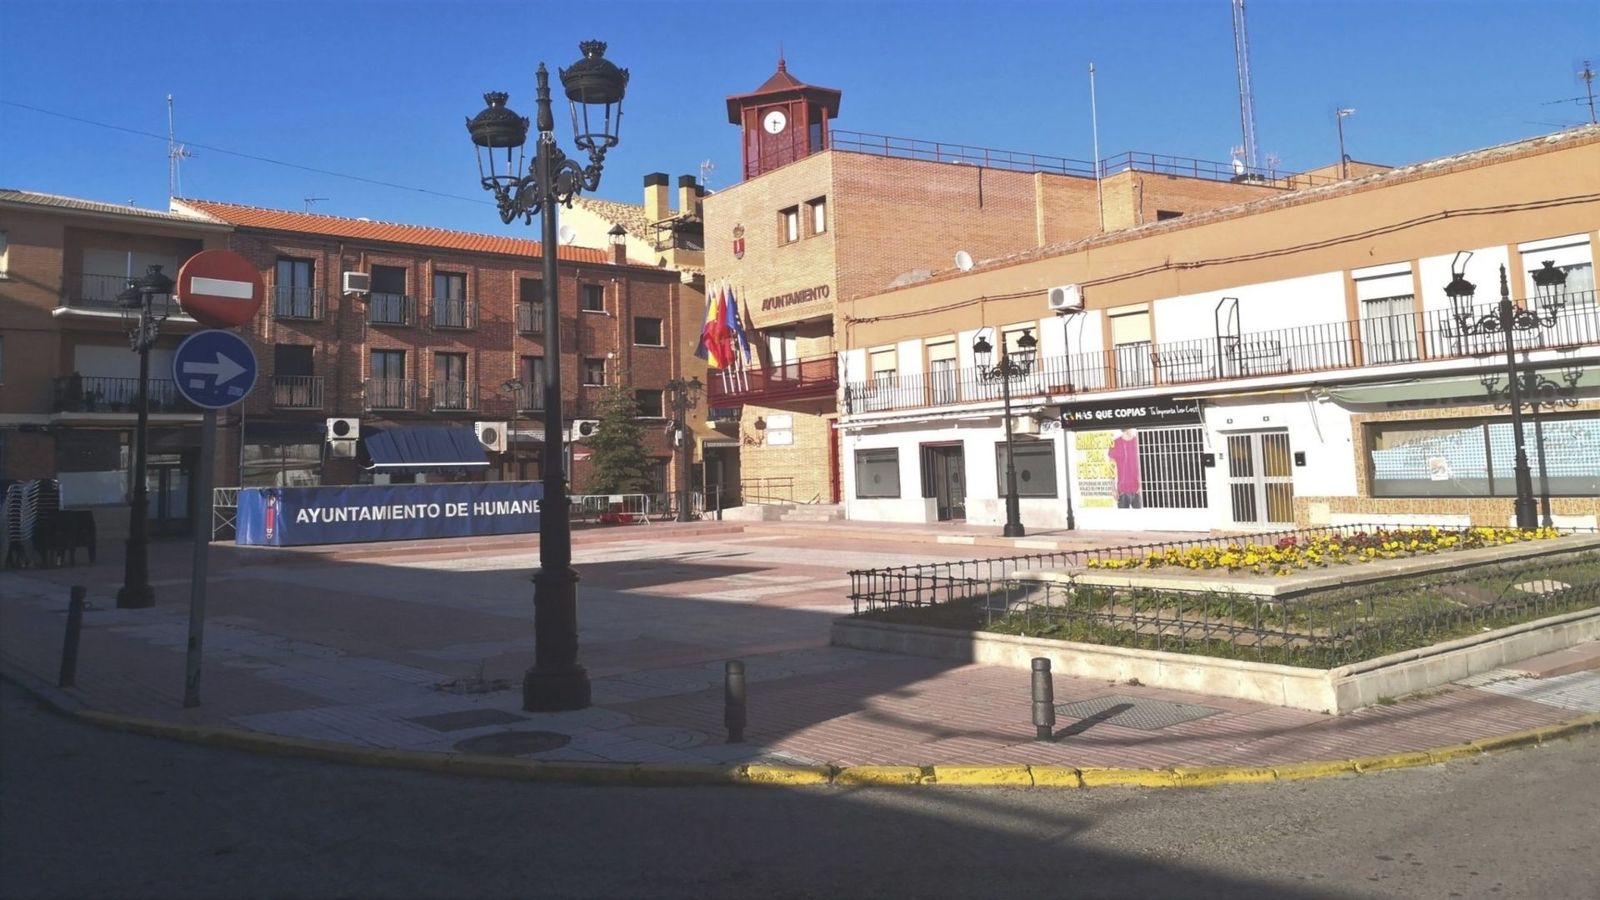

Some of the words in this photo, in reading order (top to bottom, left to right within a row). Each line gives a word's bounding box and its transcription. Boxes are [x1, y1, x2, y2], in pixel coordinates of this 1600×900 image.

[762, 284, 829, 311] AYUNTAMIENTO
[1095, 410, 1113, 420] QUE
[1115, 407, 1146, 417] COPIAS
[296, 503, 440, 523] AYUNTAMIENTO
[445, 502, 468, 518] DE
[473, 499, 540, 516] HUMANE
